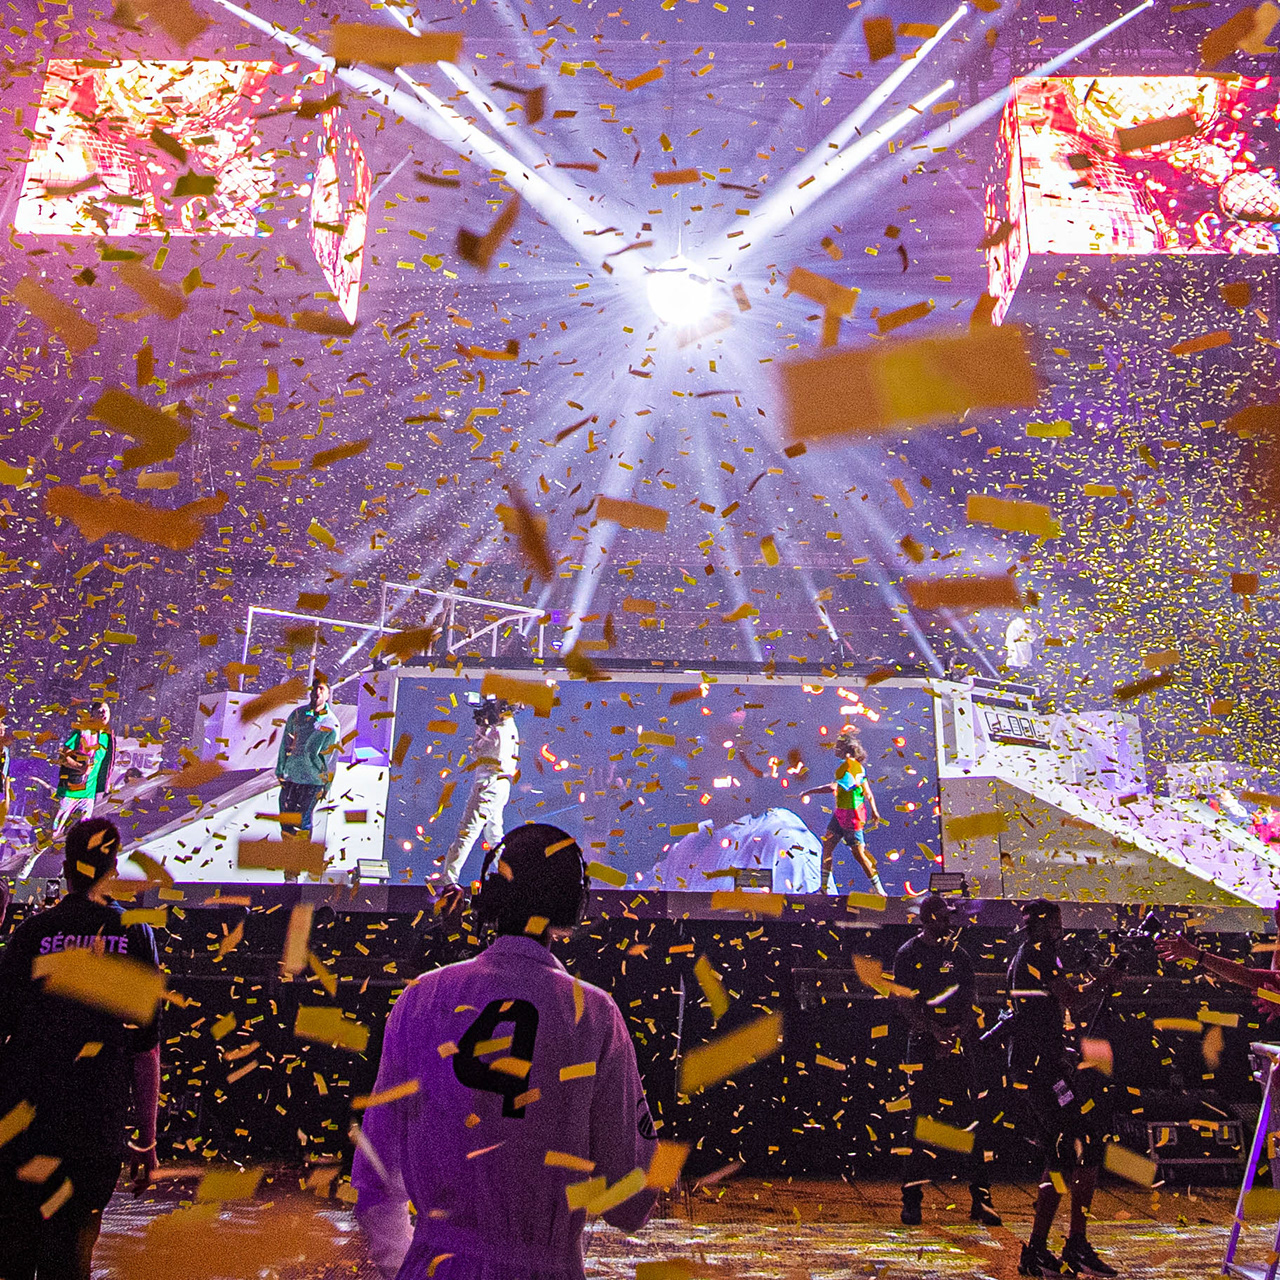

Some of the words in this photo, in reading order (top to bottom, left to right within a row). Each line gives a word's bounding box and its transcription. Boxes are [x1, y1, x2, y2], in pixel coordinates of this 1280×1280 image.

[115, 750, 154, 769] ONE
[39, 931, 129, 955] SÉCUTÉ
[453, 999, 538, 1118] 4
